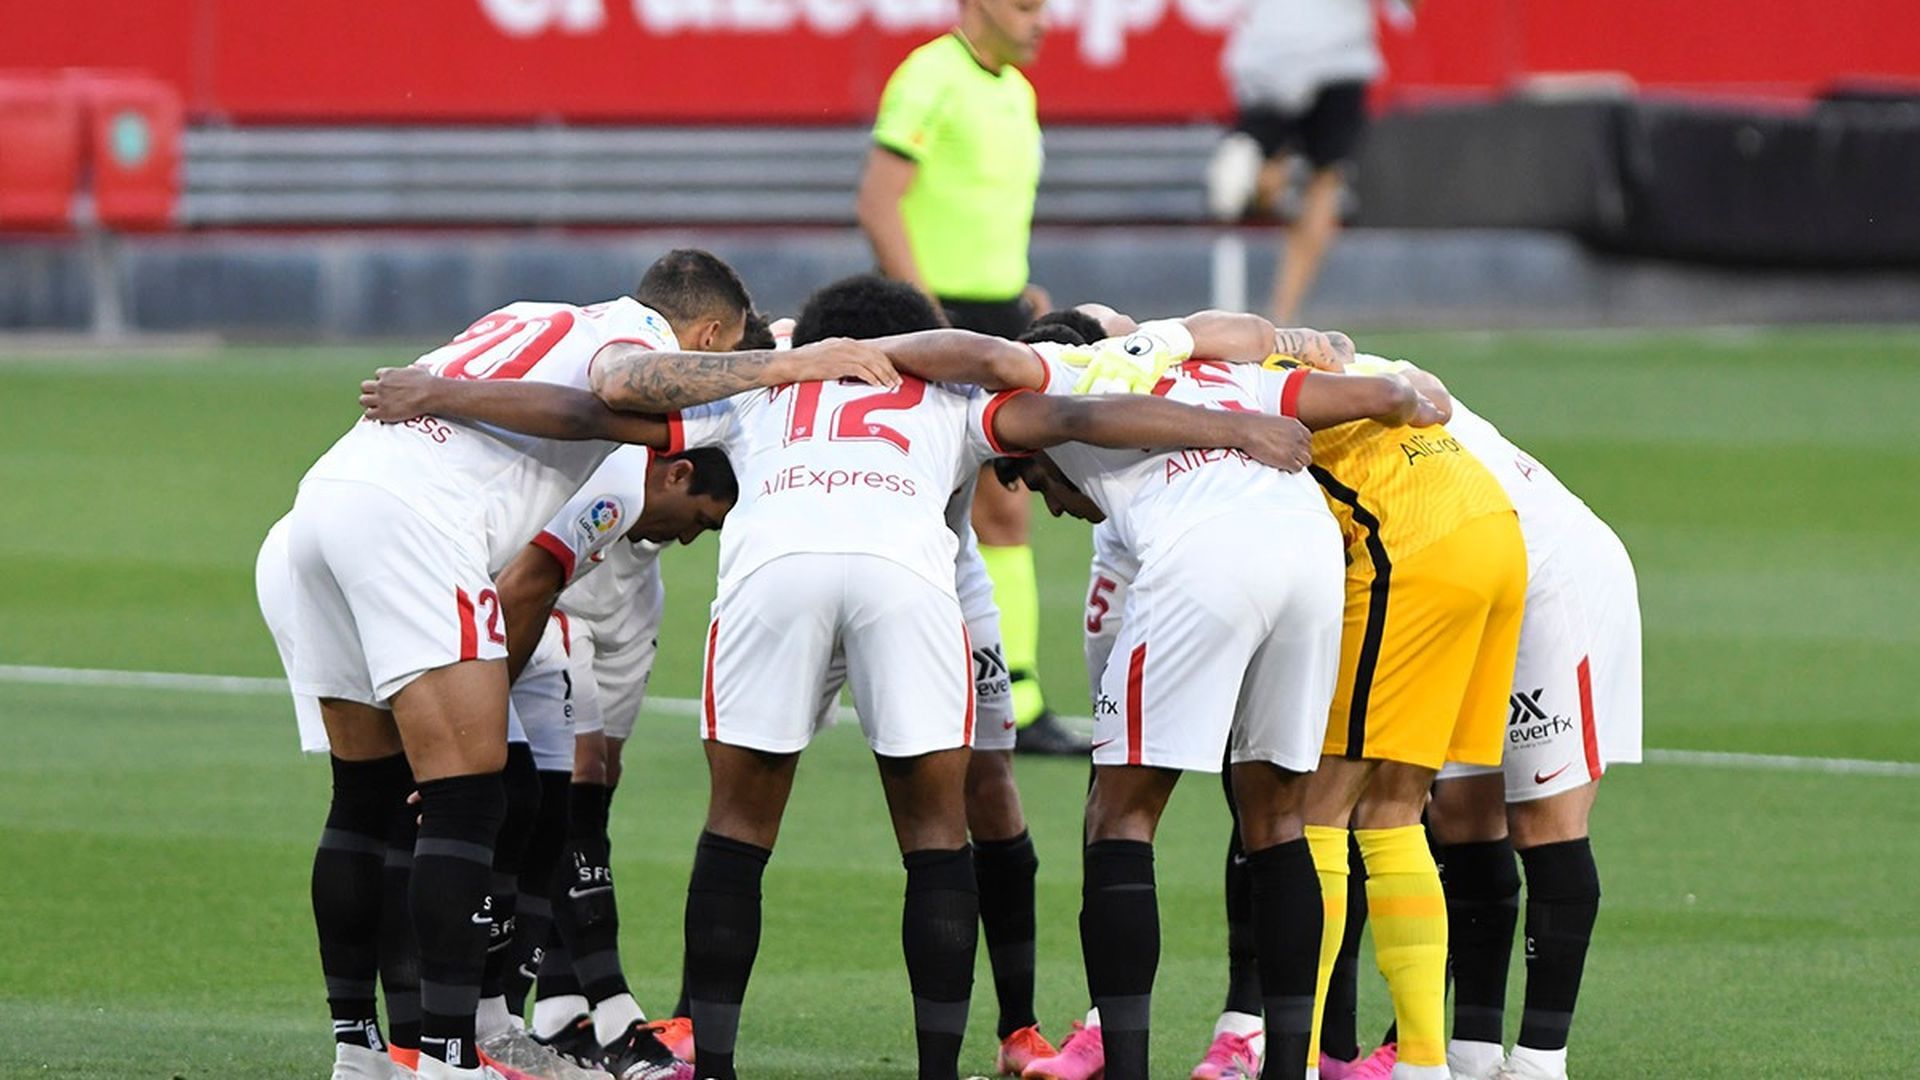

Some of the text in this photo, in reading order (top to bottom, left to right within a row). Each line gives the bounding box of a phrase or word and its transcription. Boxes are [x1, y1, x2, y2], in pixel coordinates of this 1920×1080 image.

[769, 371, 926, 456] 12
[755, 465, 916, 501] AliExpress
[977, 679, 1008, 696] eve
[1509, 715, 1574, 743] everfx
